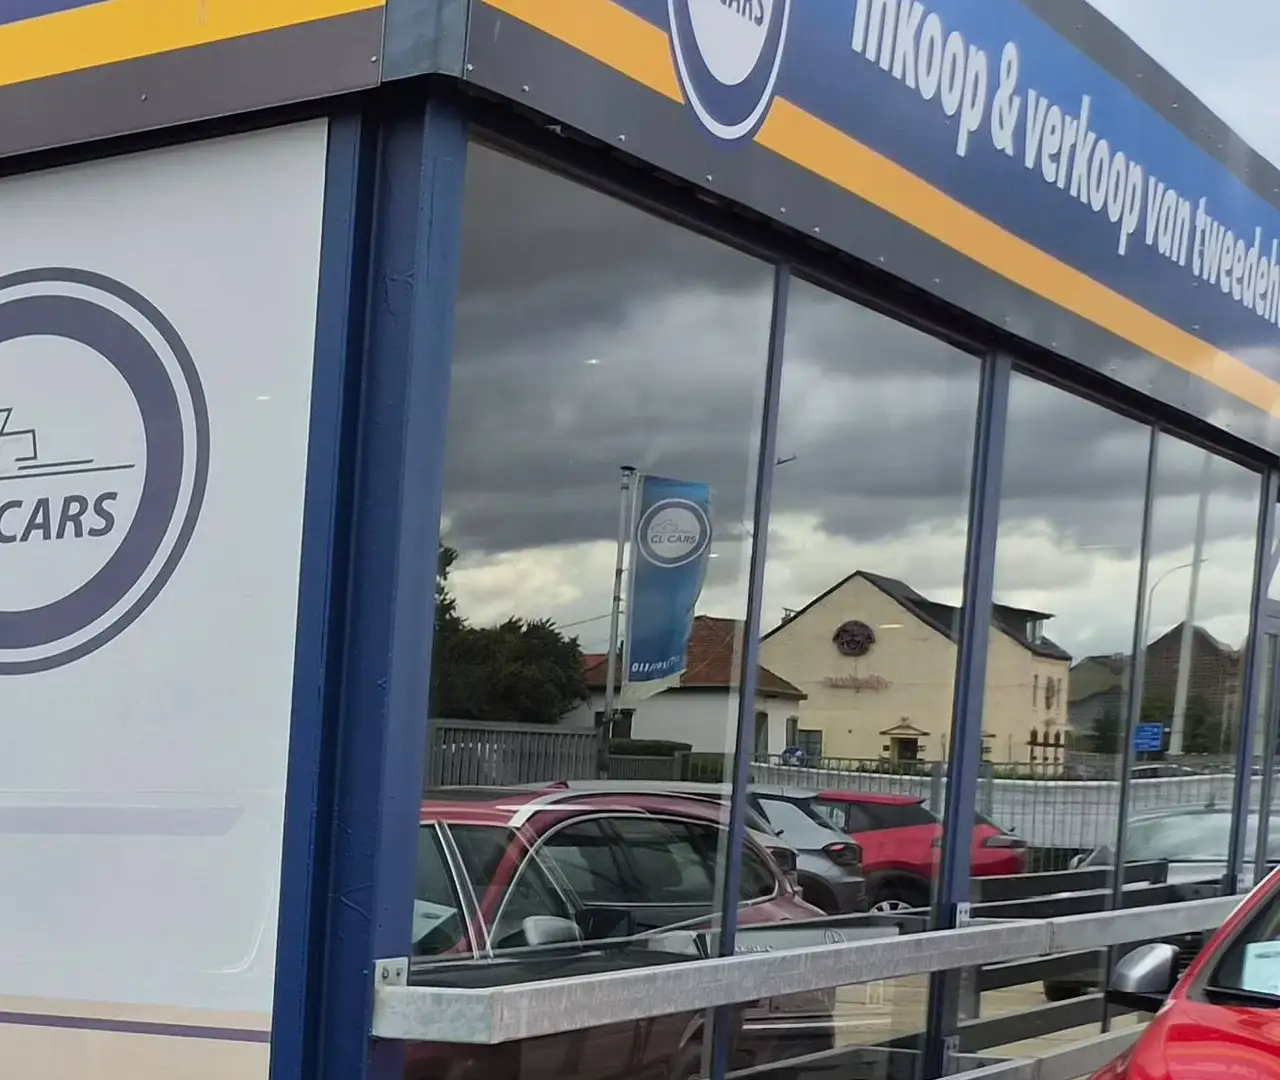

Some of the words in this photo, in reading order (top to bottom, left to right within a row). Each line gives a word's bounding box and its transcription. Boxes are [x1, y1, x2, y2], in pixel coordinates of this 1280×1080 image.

[991, 41, 1021, 157] &
[1024, 88, 1142, 256] verkoop
[1145, 175, 1191, 266] van
[1192, 196, 1280, 328] tweedeh
